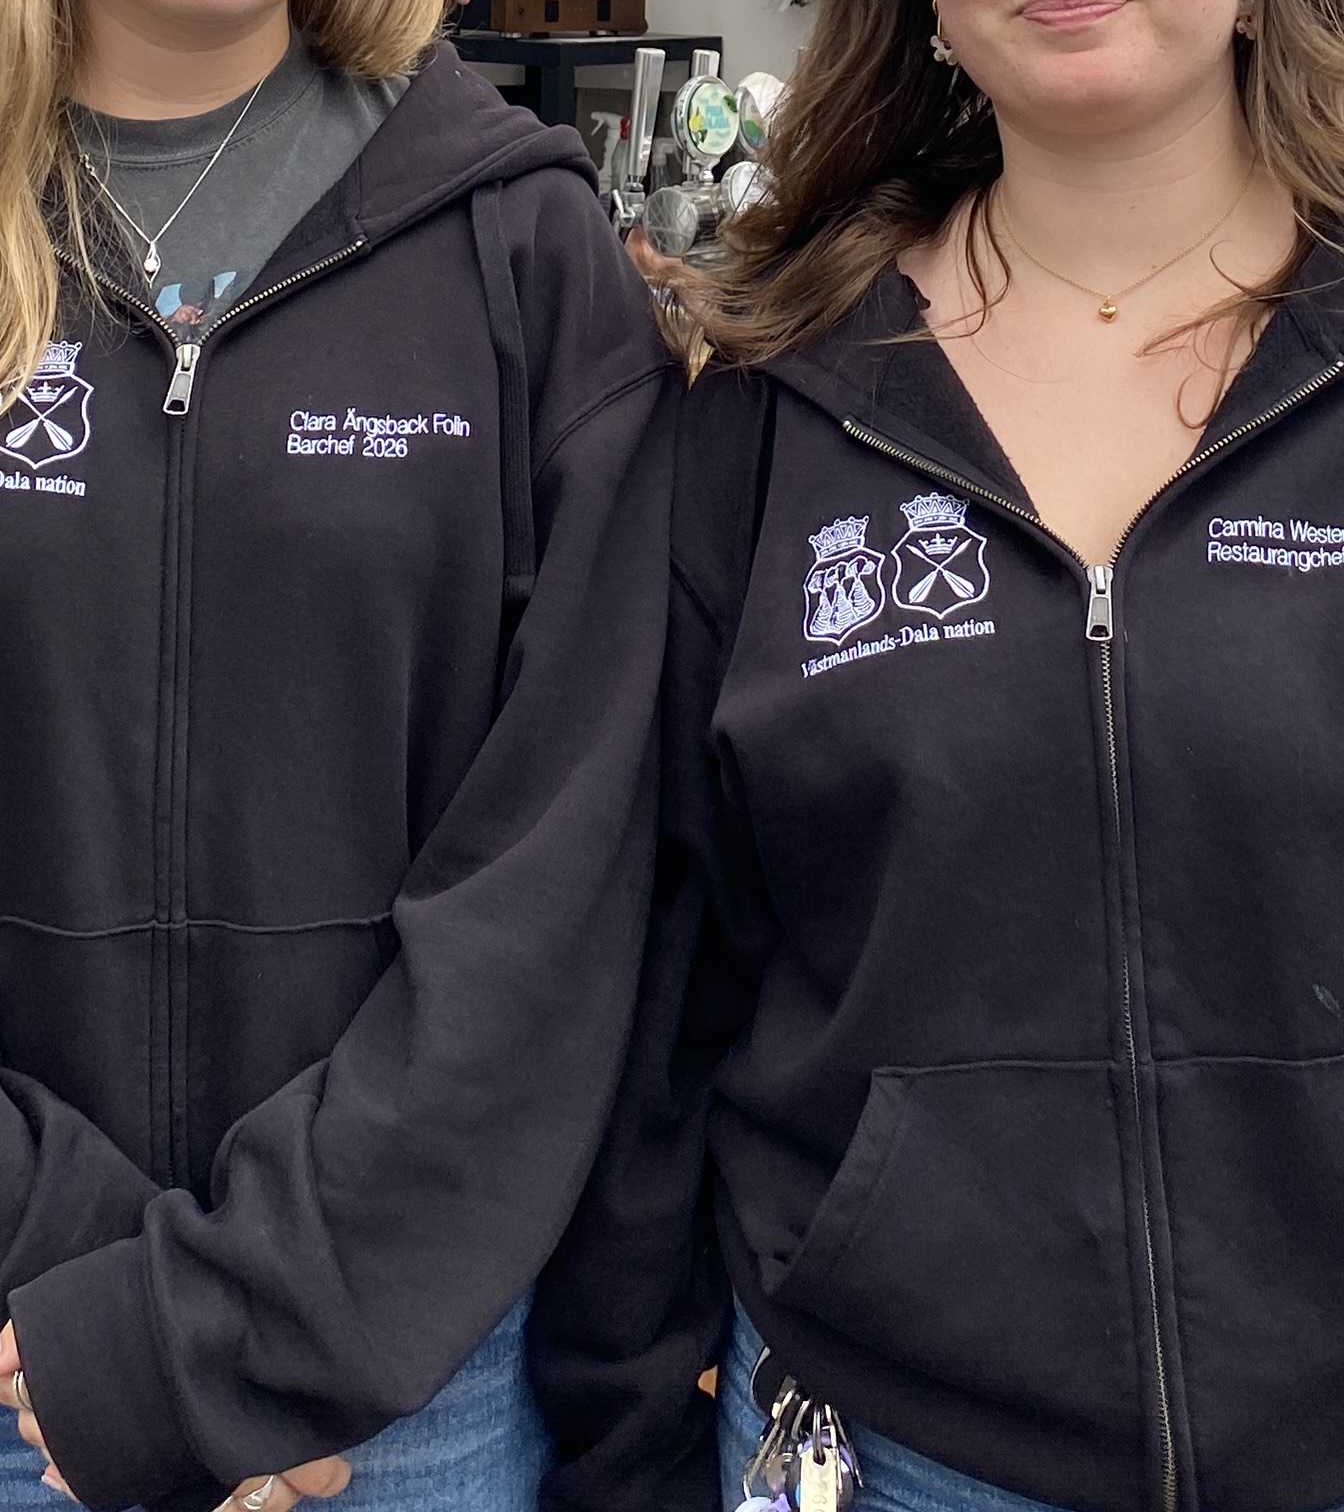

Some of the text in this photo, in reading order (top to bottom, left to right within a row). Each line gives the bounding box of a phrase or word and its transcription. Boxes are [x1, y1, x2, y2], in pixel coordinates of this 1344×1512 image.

[289, 410, 336, 431] Clara
[342, 408, 429, 437] Ängsback
[287, 434, 408, 458] Barchef 2026
[35, 474, 86, 497] nation
[1208, 516, 1285, 539] Carmina
[942, 618, 996, 639] nation
